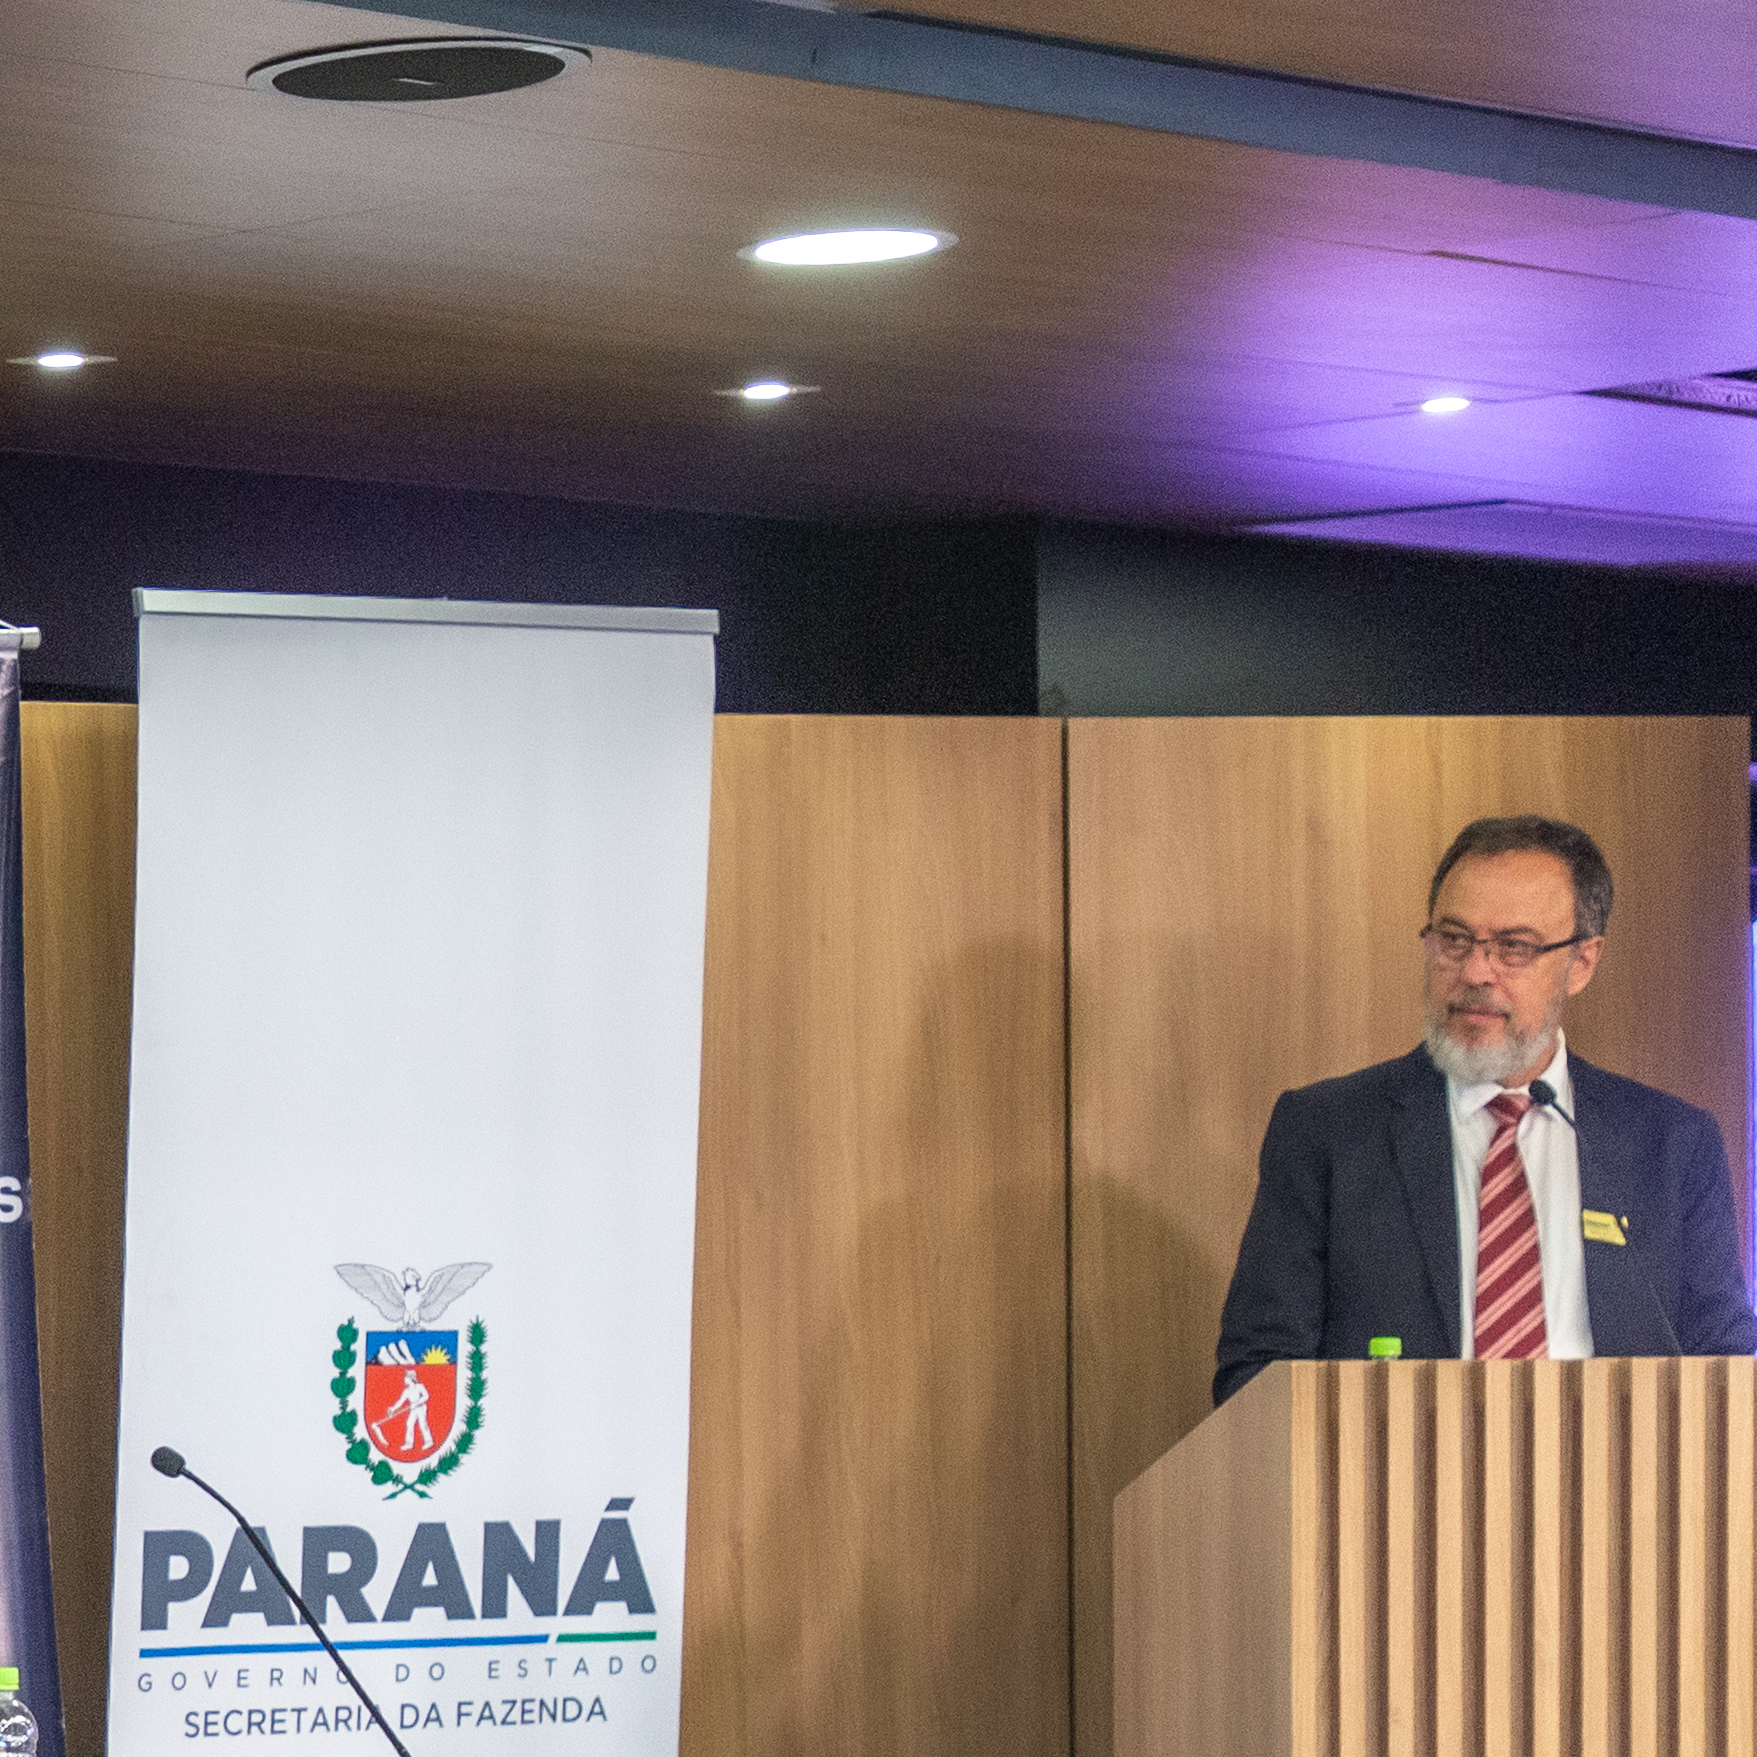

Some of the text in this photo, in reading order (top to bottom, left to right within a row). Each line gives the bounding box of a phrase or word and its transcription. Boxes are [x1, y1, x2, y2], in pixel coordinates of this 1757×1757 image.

[139, 1497, 657, 1632] PARANÁ
[138, 1654, 659, 1694] GOVERNO DO ESTADO
[184, 1695, 609, 1739] SECRETARIA DA FAZENDA
